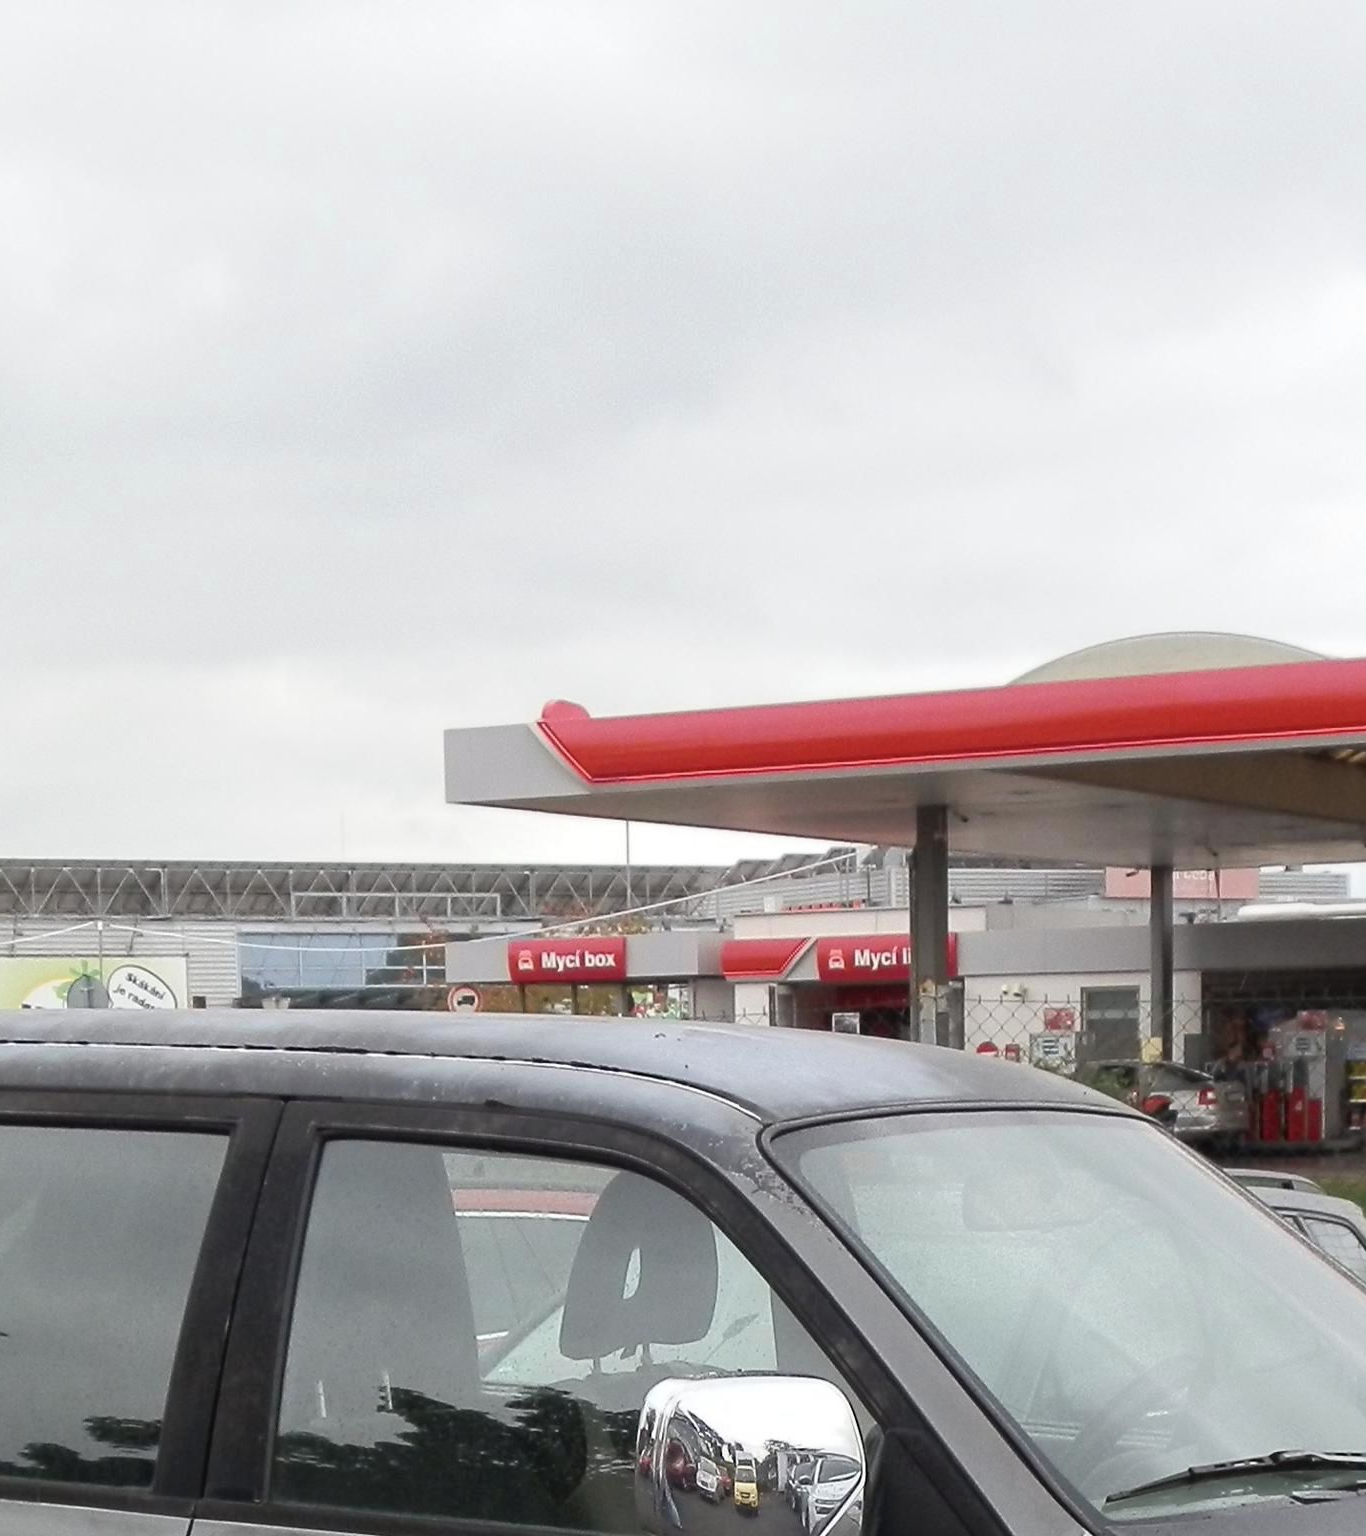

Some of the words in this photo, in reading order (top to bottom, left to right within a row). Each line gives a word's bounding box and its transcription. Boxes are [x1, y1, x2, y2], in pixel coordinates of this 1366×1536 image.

[541, 949, 581, 972] Mycí
[584, 950, 616, 968] box
[854, 946, 897, 971] Mycí
